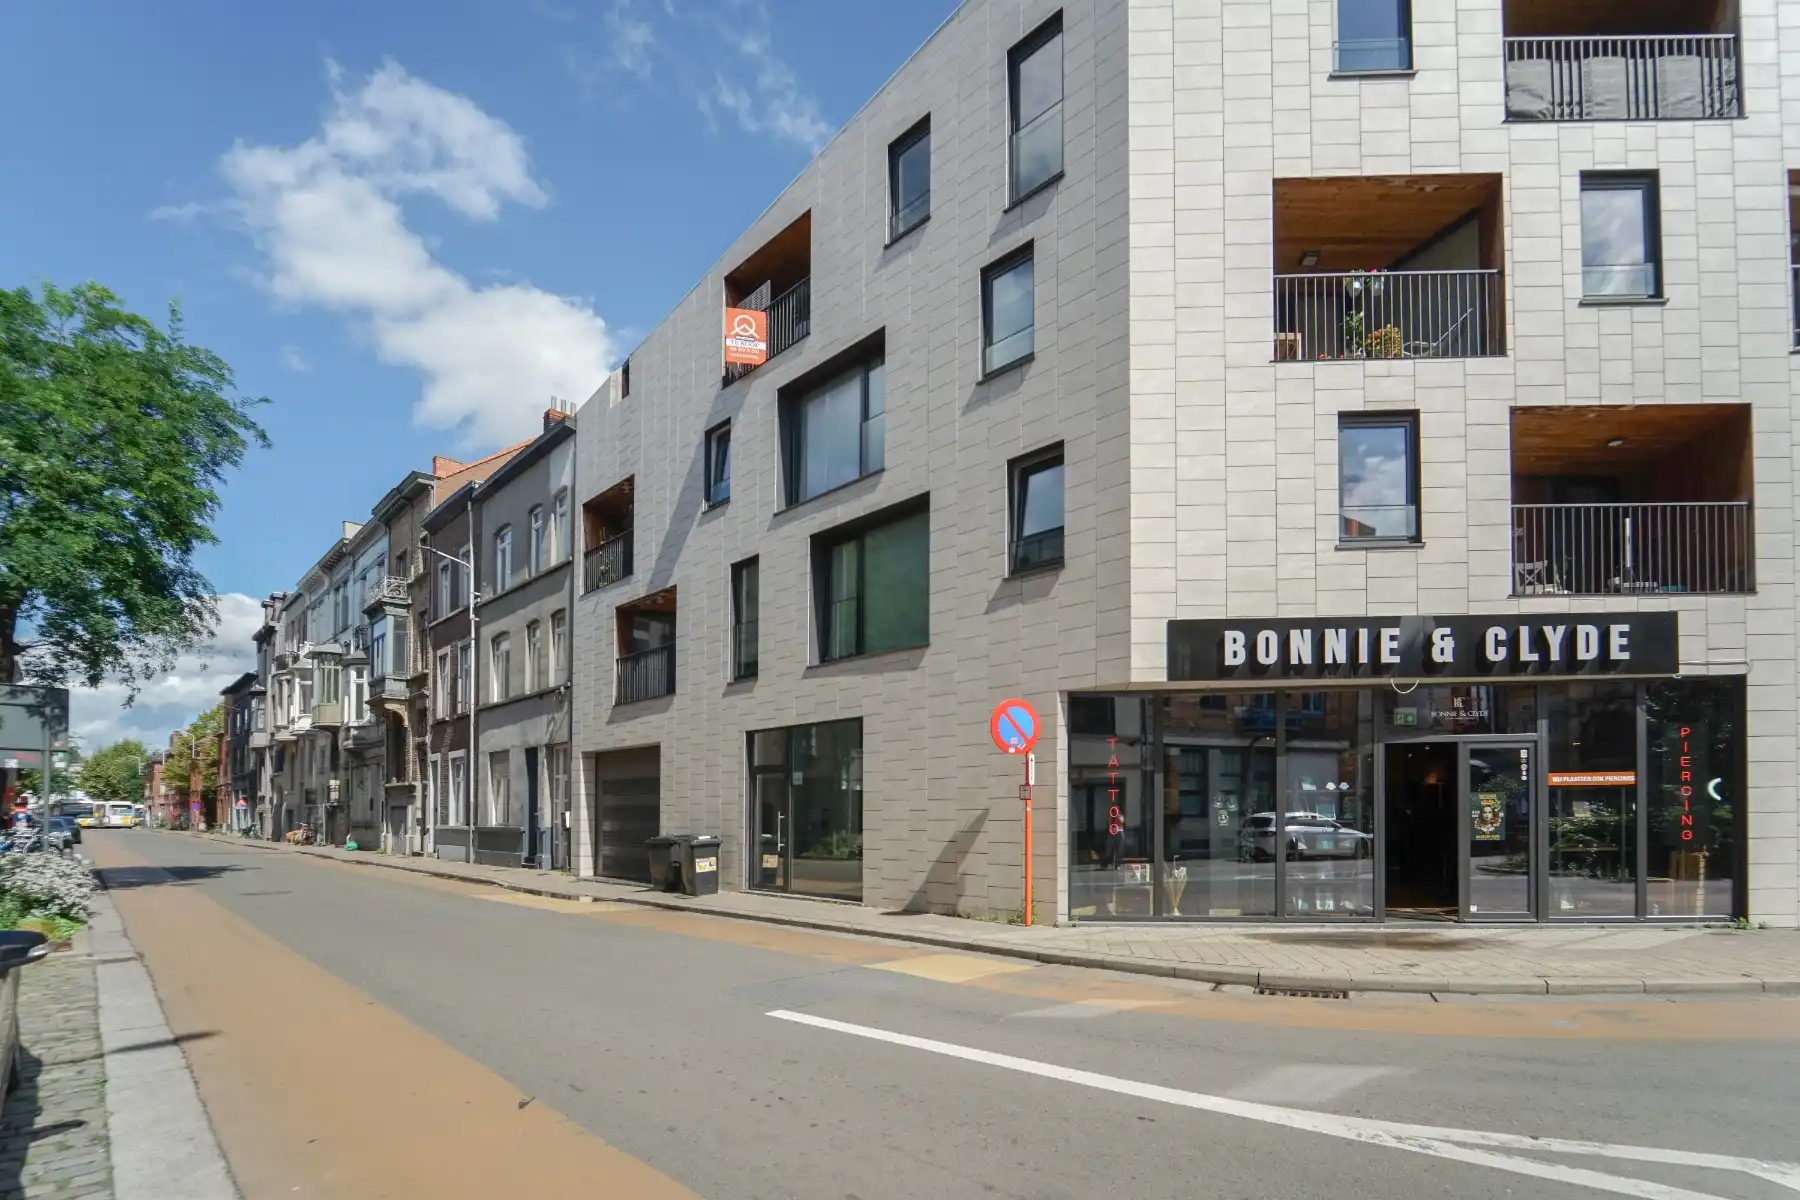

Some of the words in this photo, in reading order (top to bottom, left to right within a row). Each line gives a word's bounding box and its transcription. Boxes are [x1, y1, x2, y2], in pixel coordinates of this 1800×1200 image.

[1223, 627, 1401, 666] BONNIE
[1431, 627, 1456, 662] &
[1485, 624, 1631, 662] CLYDE
[1107, 737, 1119, 836] TATTOO
[1680, 727, 1693, 841] PIERCING
